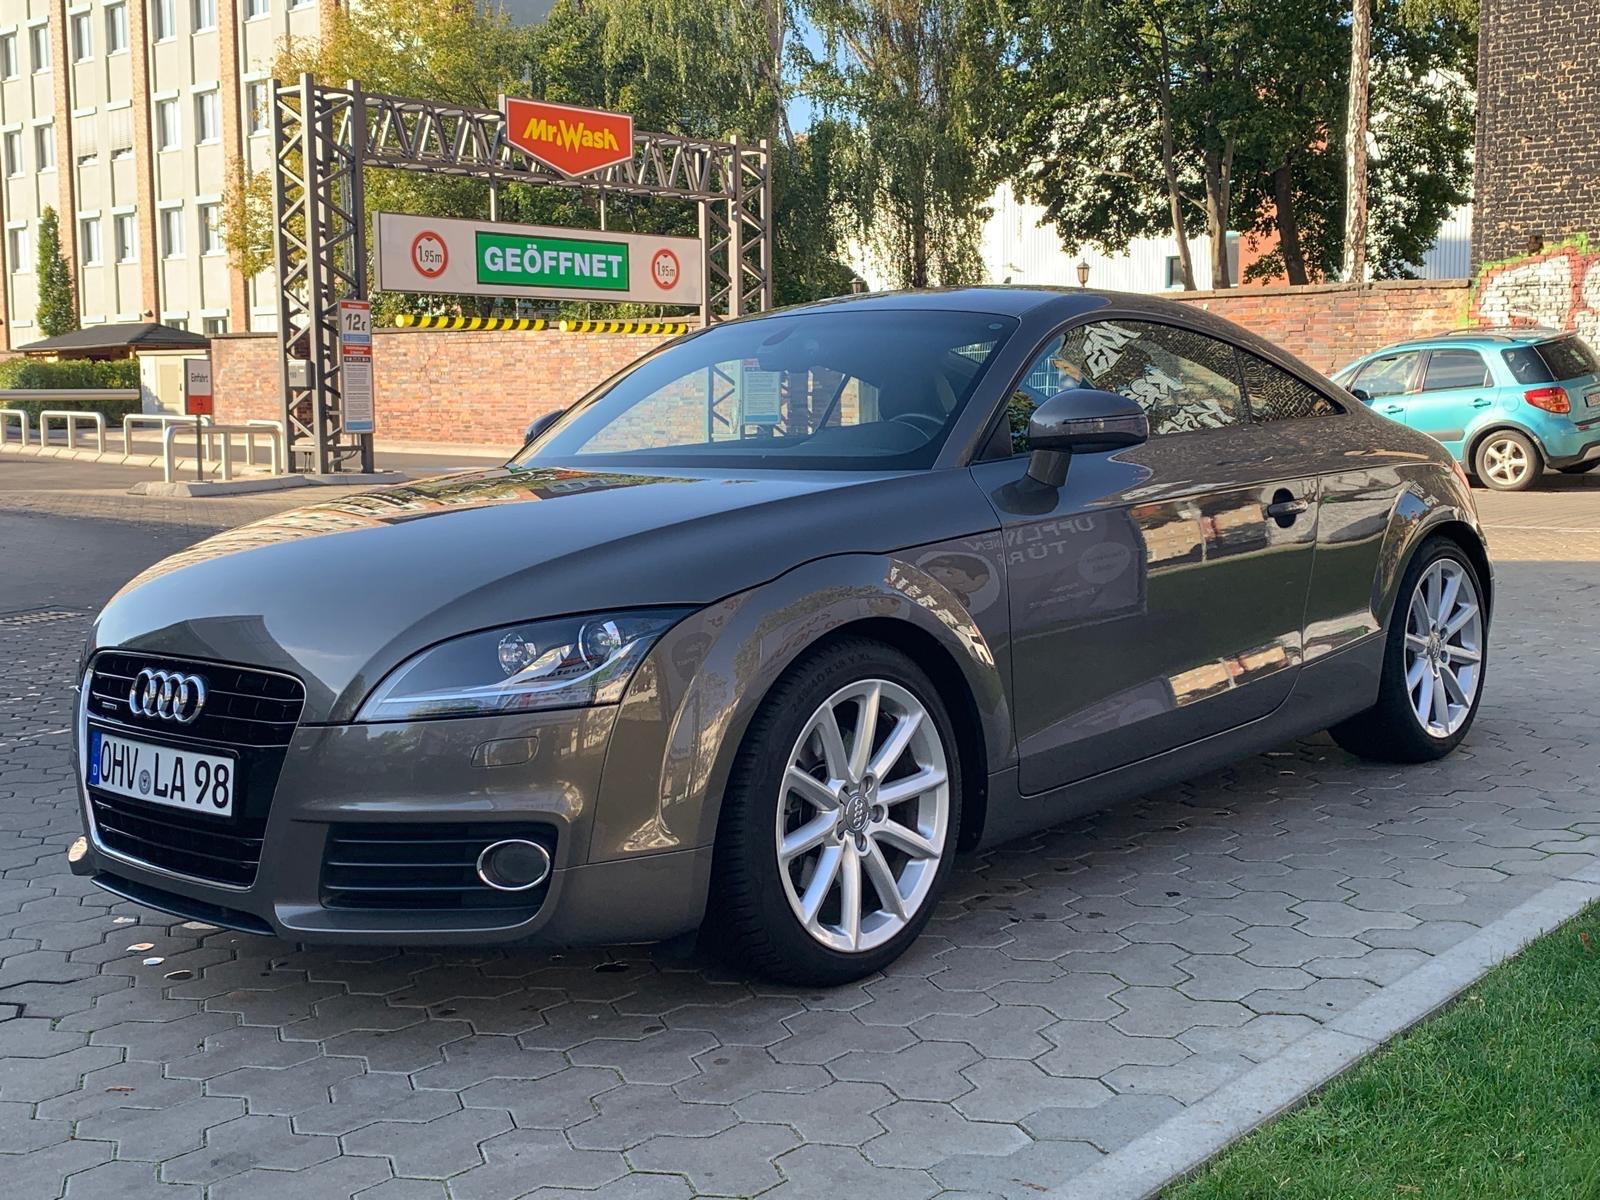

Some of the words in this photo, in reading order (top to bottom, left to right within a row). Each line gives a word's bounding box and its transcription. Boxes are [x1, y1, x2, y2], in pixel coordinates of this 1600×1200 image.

[484, 243, 623, 278] GEÖFFNET
[100, 740, 139, 790] OHV
[153, 752, 185, 801] LA
[194, 760, 230, 809] 98
